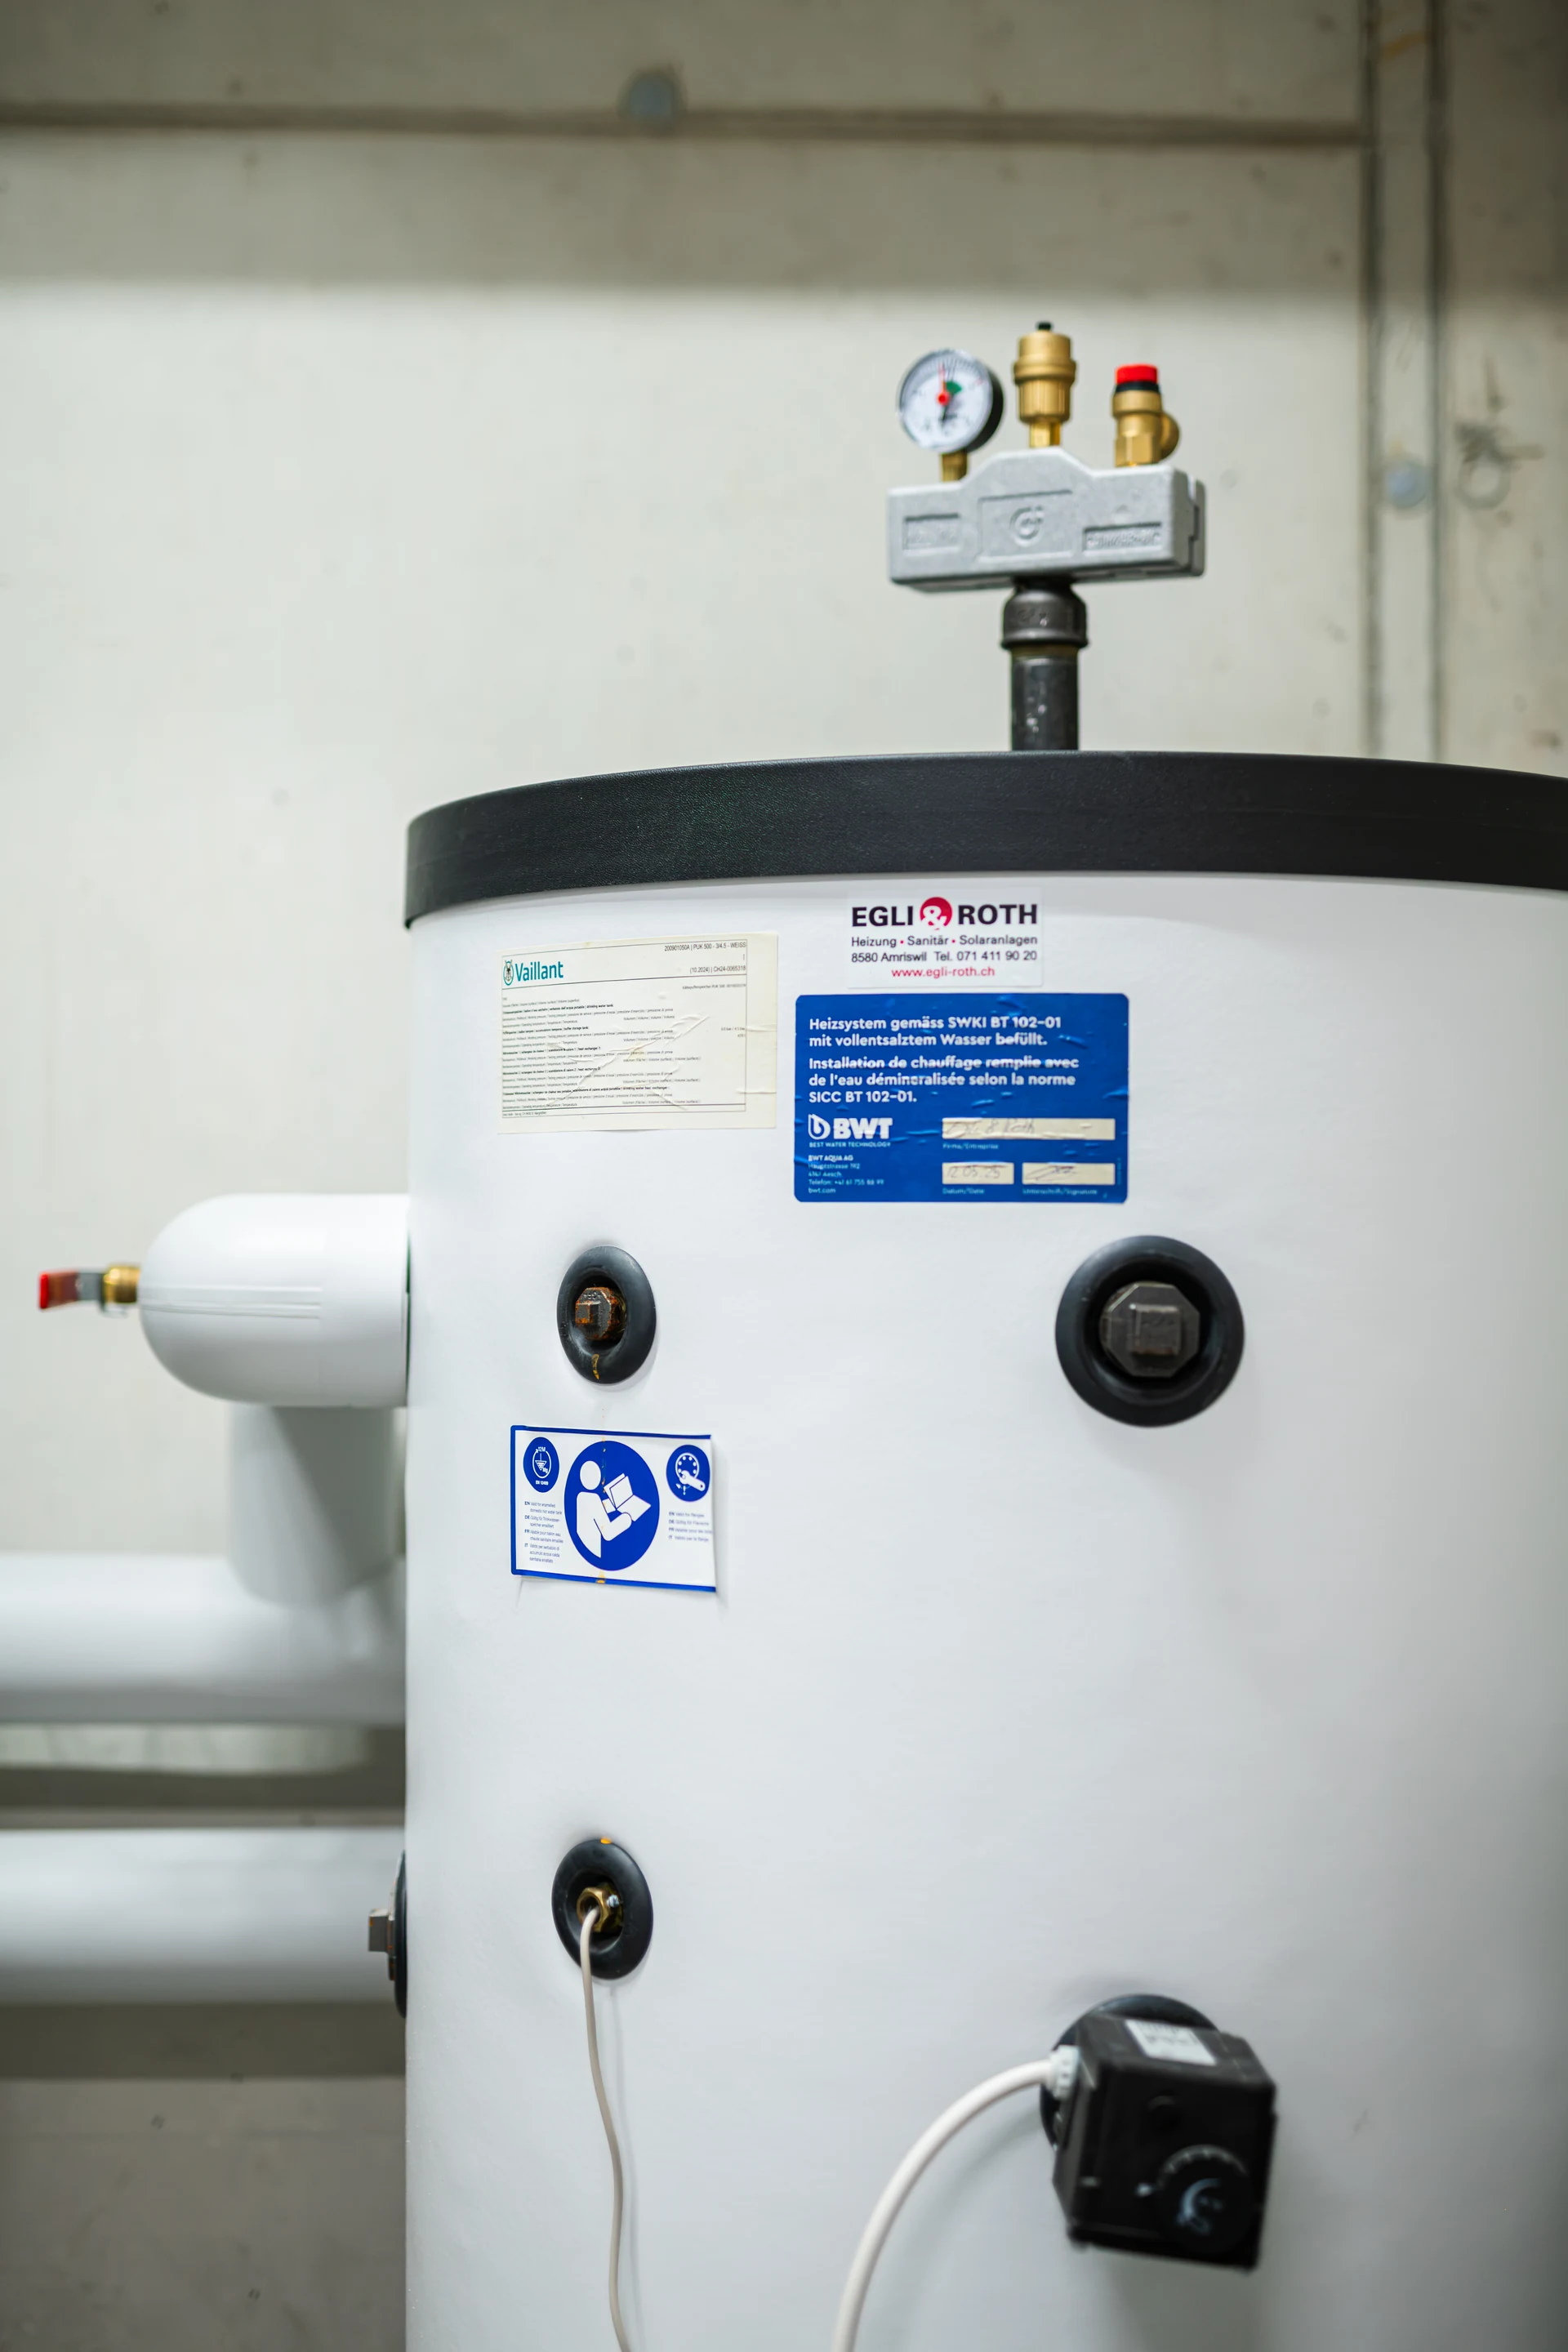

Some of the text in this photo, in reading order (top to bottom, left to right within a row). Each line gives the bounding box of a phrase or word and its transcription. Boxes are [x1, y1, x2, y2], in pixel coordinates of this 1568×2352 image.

[851, 903, 1038, 931] EGLI & ROTH
[851, 934, 1038, 948] Heizung Sanitär Solaranlagen
[851, 950, 1038, 963] 8580 Amriswil Tel. 071 411 90 20
[514, 960, 564, 982] Vaillant
[891, 966, 996, 979] www.egli-roth.ch
[808, 1015, 1062, 1032] Heizsystem gemäss SWKI BT 102-01
[808, 1032, 1049, 1047] mit vollentsalztem Wasser befüllt.
[808, 1054, 1080, 1071] Installation de chauffage remplie avec
[808, 1072, 826, 1087] de
[829, 1072, 863, 1087] l'eau
[969, 1071, 1009, 1086] selon
[1011, 1071, 1026, 1086] la
[1027, 1075, 1076, 1086] norme
[808, 1090, 918, 1103] SICC BT 102-01.
[833, 1117, 893, 1140] BWT
[808, 1154, 854, 1163] BWT AQUA AG
